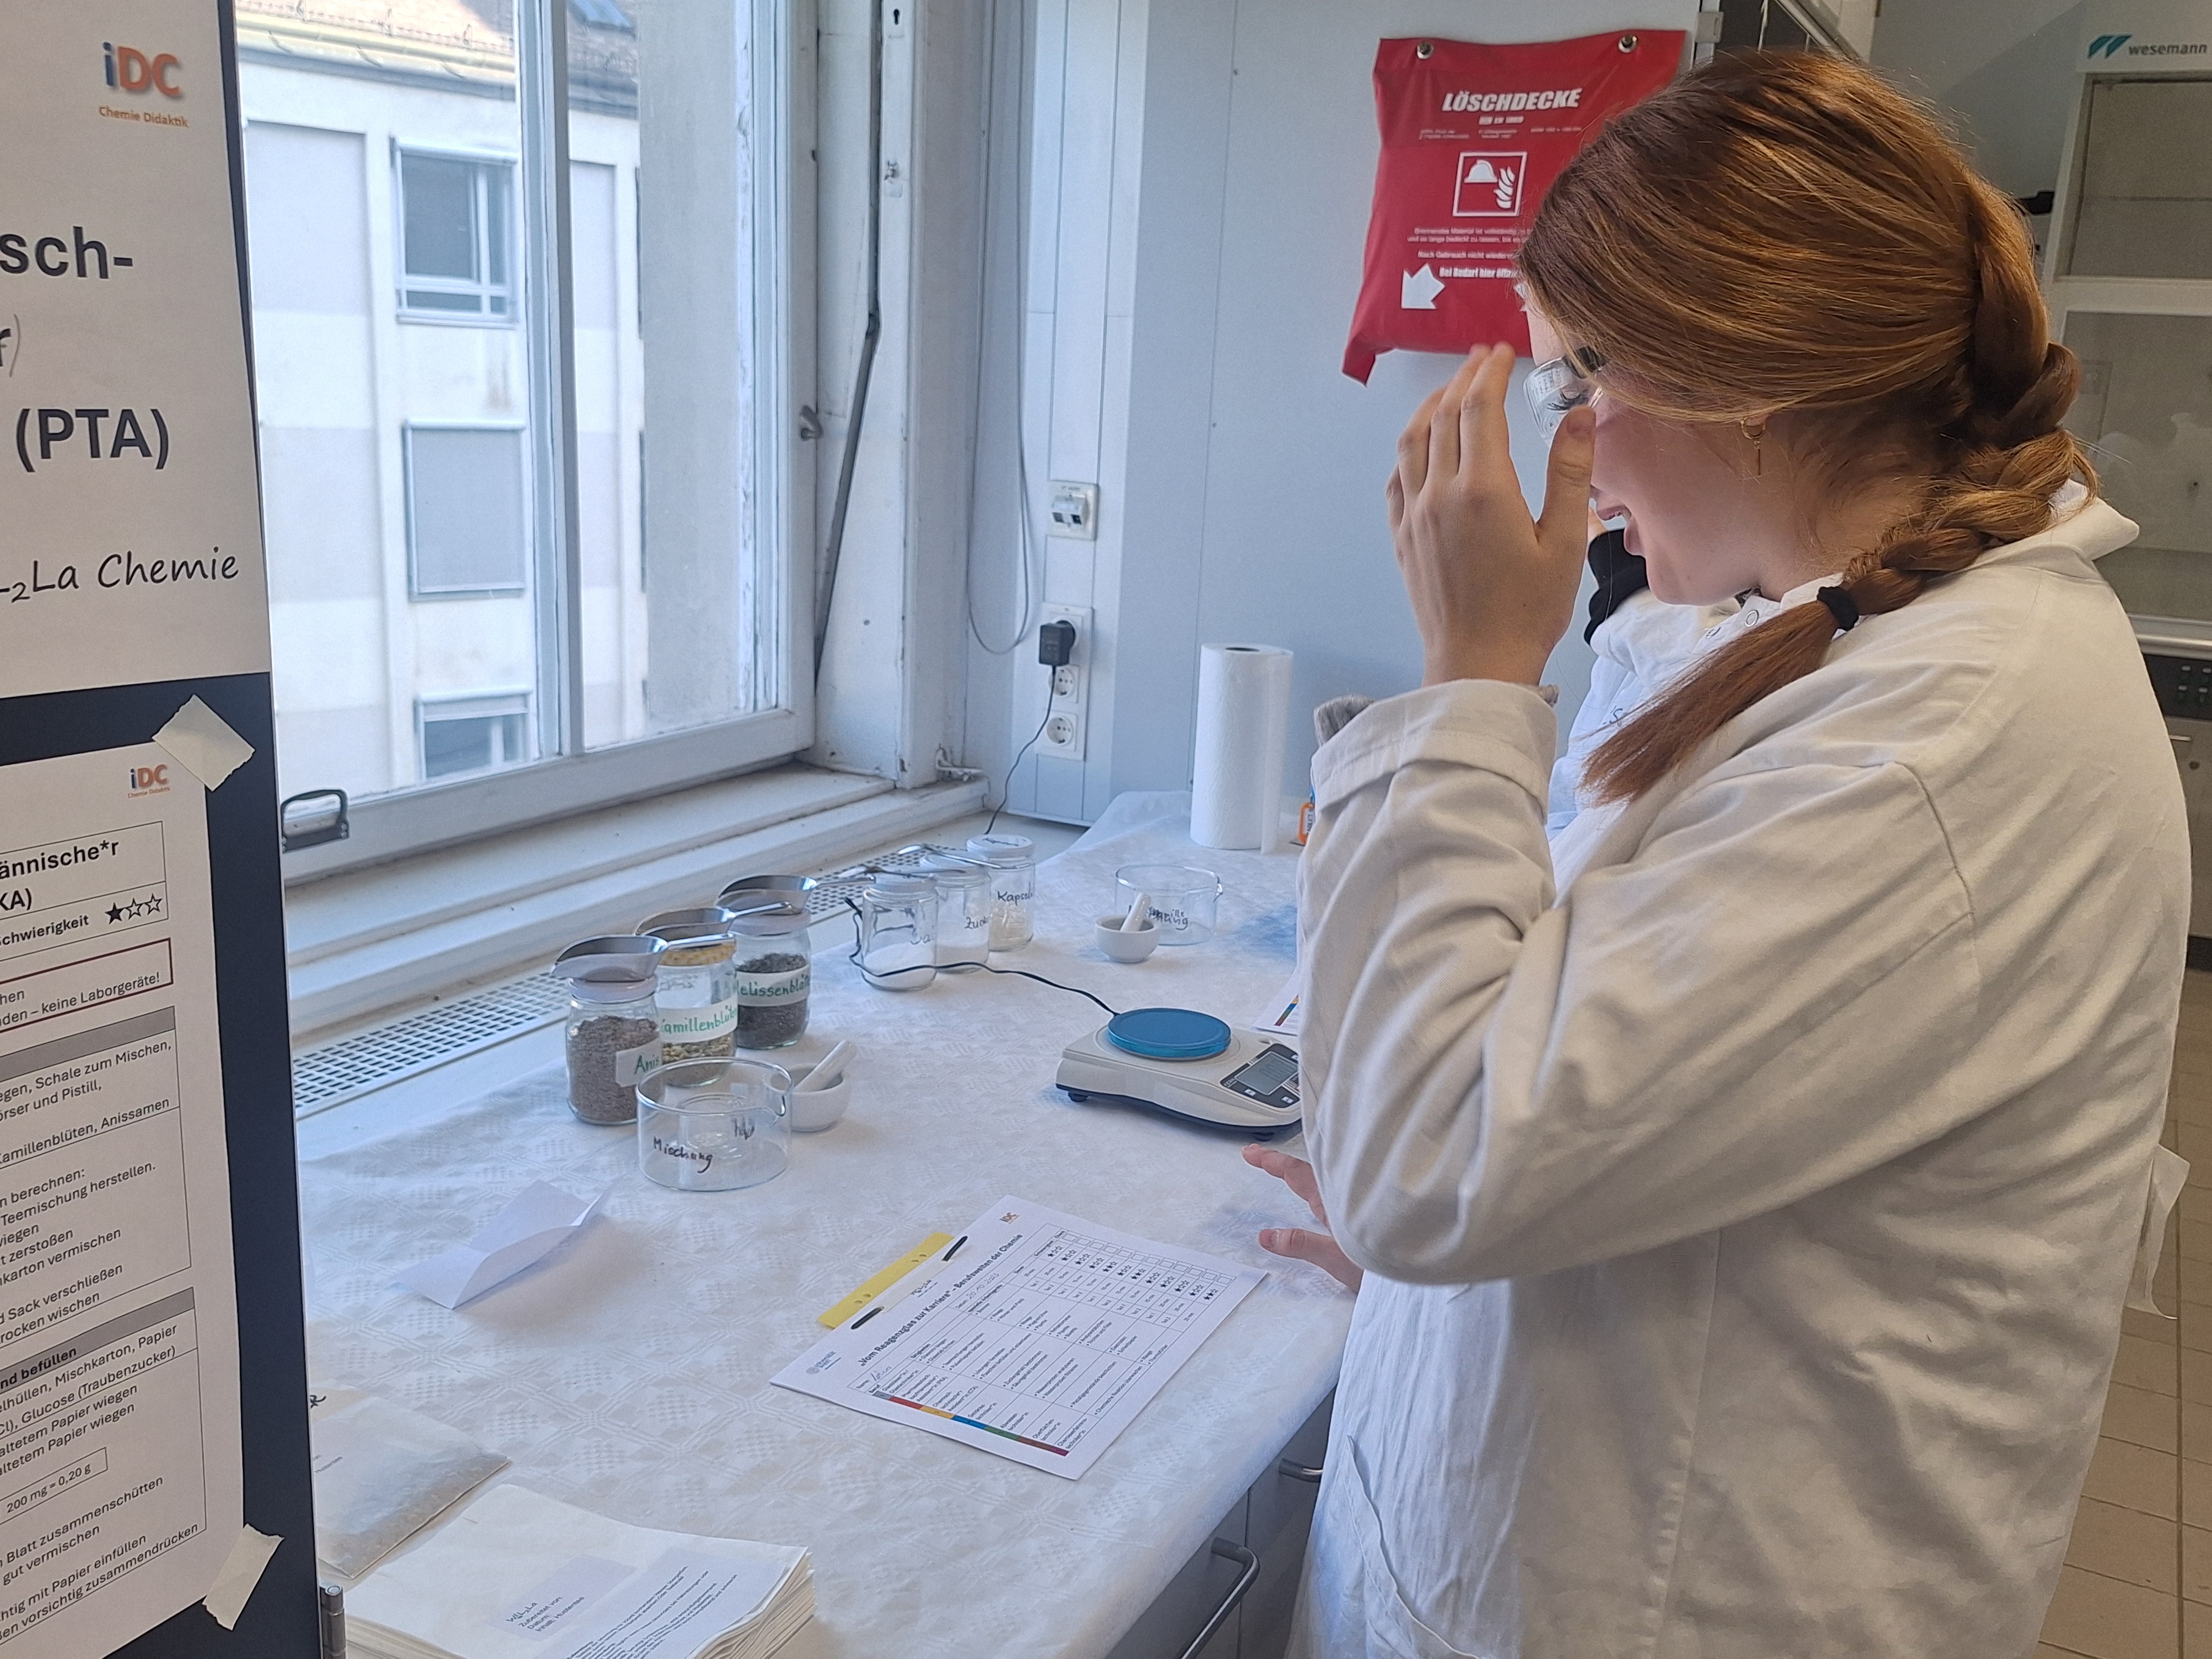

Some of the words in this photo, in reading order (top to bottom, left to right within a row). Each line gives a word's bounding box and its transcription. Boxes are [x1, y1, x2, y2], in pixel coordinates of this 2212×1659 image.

[102, 42, 181, 97] iDC
[2129, 44, 2207, 55] wesemann
[99, 106, 139, 121] Chemie
[144, 112, 189, 128] Didaktik
[1442, 87, 1583, 112] LÖSCHDECKE
[0, 226, 133, 279] sch-
[16, 409, 169, 472] (PTA)
[0, 561, 79, 603] 2La
[98, 546, 239, 588] Chemie
[130, 764, 168, 789] iDC
[42, 996, 77, 1014] keine
[81, 972, 160, 1004] Laborgeräte!
[35, 1068, 81, 1089] Schale
[84, 1058, 112, 1075] zum
[115, 1041, 171, 1065] Mischen,
[33, 1094, 58, 1109] und
[62, 1079, 102, 1101] Pistill,
[101, 1098, 170, 1129] Anissamen
[653, 1137, 713, 1173] Mischung
[1, 1186, 88, 1226] Teemischung
[90, 1163, 156, 1192] herstellen.
[11, 1169, 85, 1204] berechnen:
[9, 1230, 73, 1263] zerstoßen
[48, 1230, 121, 1264] vermischen
[8, 1300, 40, 1321] Sack
[43, 1265, 123, 1305] verschließen
[48, 1293, 100, 1322] wischen
[874, 1320, 918, 1352] Reagenzglas
[914, 1311, 927, 1320] zur
[989, 1251, 1001, 1259] der
[999, 1234, 1023, 1252] Chemie
[22, 1348, 76, 1378] befüllen
[55, 1345, 135, 1386] Mischkarton,
[138, 1325, 177, 1349] Papier
[22, 1393, 75, 1423] Glucose
[78, 1346, 176, 1399] (Traubenzucker)
[52, 1405, 90, 1432] Papier
[93, 1385, 137, 1410] wiegen
[48, 1425, 88, 1451] Papier
[90, 1403, 135, 1430] wiegen
[7, 1495, 28, 1513] 200
[30, 1486, 48, 1500] mg
[59, 1468, 82, 1486] 0,20
[84, 1464, 91, 1475] g
[7, 1540, 37, 1564] Blatt
[40, 1476, 163, 1546] zusammenschütten
[0, 1601, 25, 1621] htig
[28, 1586, 49, 1607] mit
[52, 1564, 92, 1592] Papier
[94, 1535, 146, 1568] einfüllen
[3, 1567, 23, 1586] gut
[25, 1525, 100, 1570] vermischen
[22, 1585, 83, 1626] vorsichtig
[86, 1524, 198, 1592] zusammendrücken
